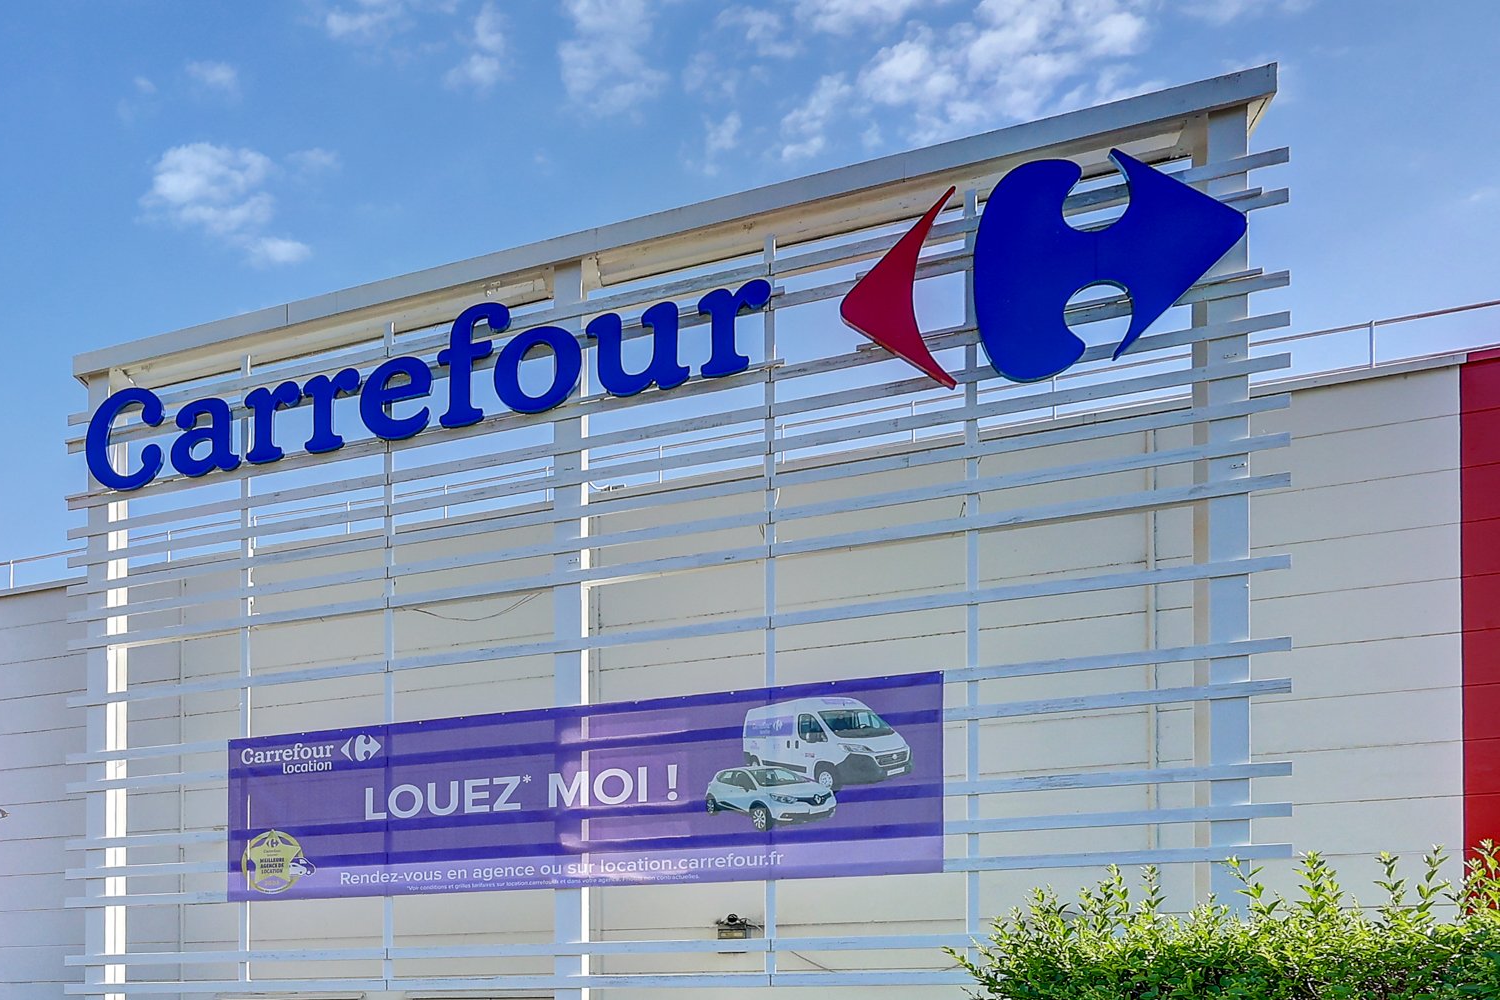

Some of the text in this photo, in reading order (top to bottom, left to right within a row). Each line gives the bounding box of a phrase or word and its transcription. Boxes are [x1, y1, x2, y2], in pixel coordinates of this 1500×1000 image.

[85, 279, 772, 491] Carrefour
[241, 743, 334, 765] Carrefour
[282, 760, 332, 774] location
[548, 766, 647, 808] MOI
[667, 763, 679, 801] !
[340, 851, 784, 885] Rendez-vous en agence ou sur location.carrefour.fr
[420, 883, 447, 891] conditions
